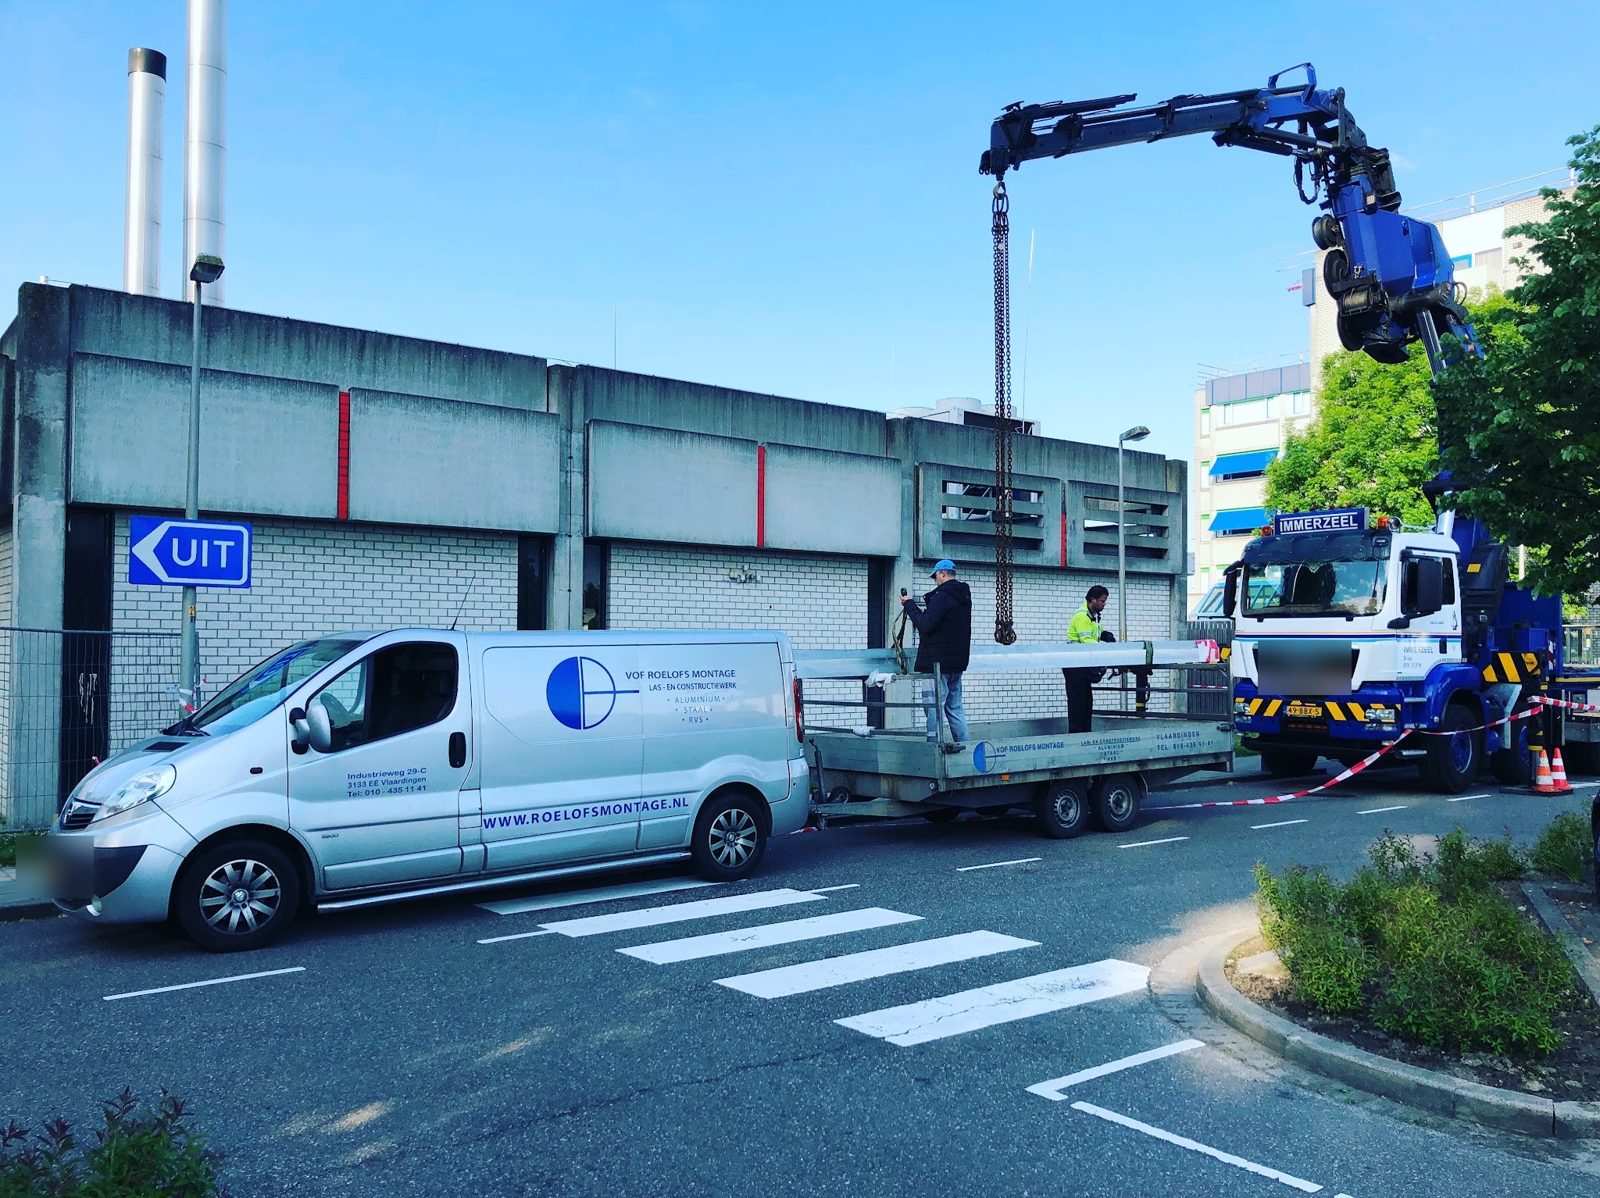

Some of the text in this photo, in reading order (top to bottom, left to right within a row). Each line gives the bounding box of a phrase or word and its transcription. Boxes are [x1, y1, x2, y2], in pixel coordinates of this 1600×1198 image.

[1280, 515, 1358, 532] IMMERZEEL
[172, 537, 235, 568] UIT
[625, 669, 736, 680] VOF ROELOFS MONTAGE
[676, 682, 737, 690] CONSTRUCTIEWERK
[674, 695, 720, 704] ALUMINIUM
[684, 706, 708, 714] STAAL
[996, 742, 1064, 753] VOF ROELOFS MONTAGE
[348, 770, 405, 780] Industrieweg
[348, 780, 366, 788] 3133
[382, 777, 427, 786] Vlaardingen
[364, 788, 380, 796] 010
[388, 786, 403, 794] 435
[483, 797, 689, 829] WWW.ROELOFSMONTAGE.NL
